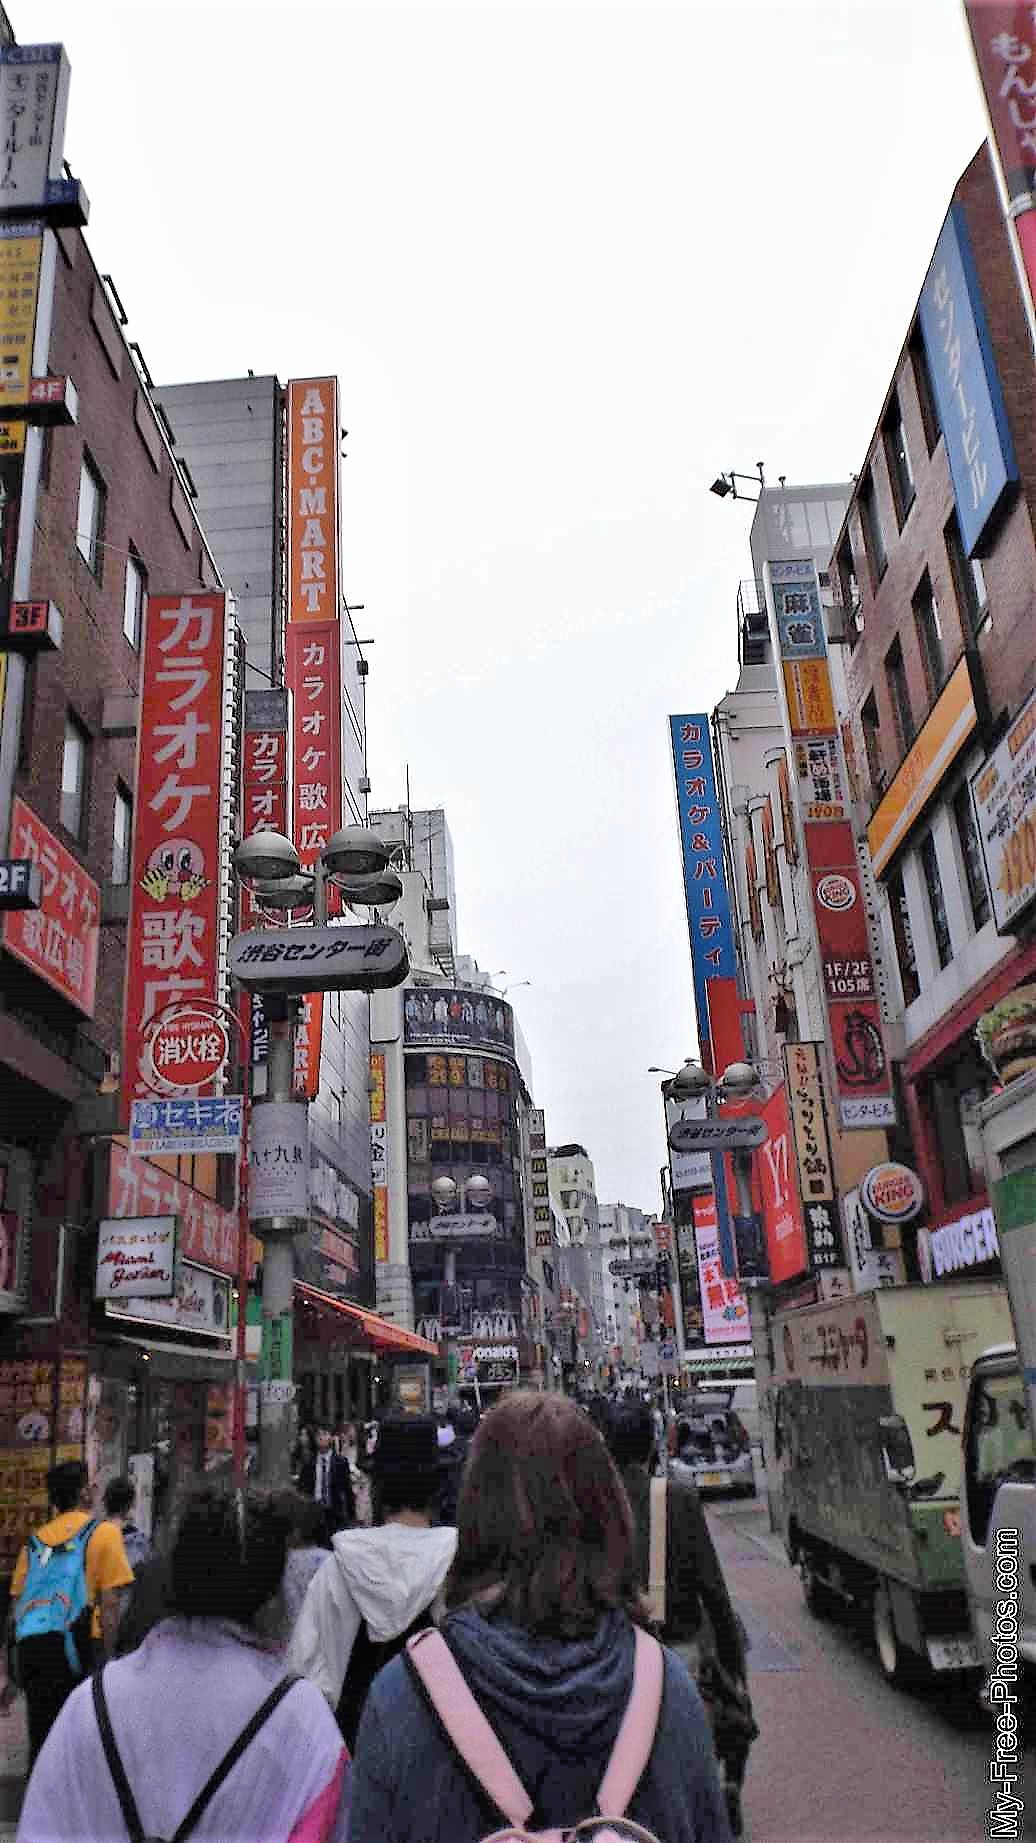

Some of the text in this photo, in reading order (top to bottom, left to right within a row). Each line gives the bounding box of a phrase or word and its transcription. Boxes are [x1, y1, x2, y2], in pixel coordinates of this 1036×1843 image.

[31, 384, 61, 400] 4F
[934, 263, 986, 511] センタービル
[15, 606, 41, 624] 3F
[149, 599, 214, 833] カラオケ
[299, 643, 328, 875] カラオケ歌広
[824, 961, 870, 976] 1F/2F
[158, 1033, 222, 1066] 消火栓
[930, 1206, 1000, 1277] BURGER
